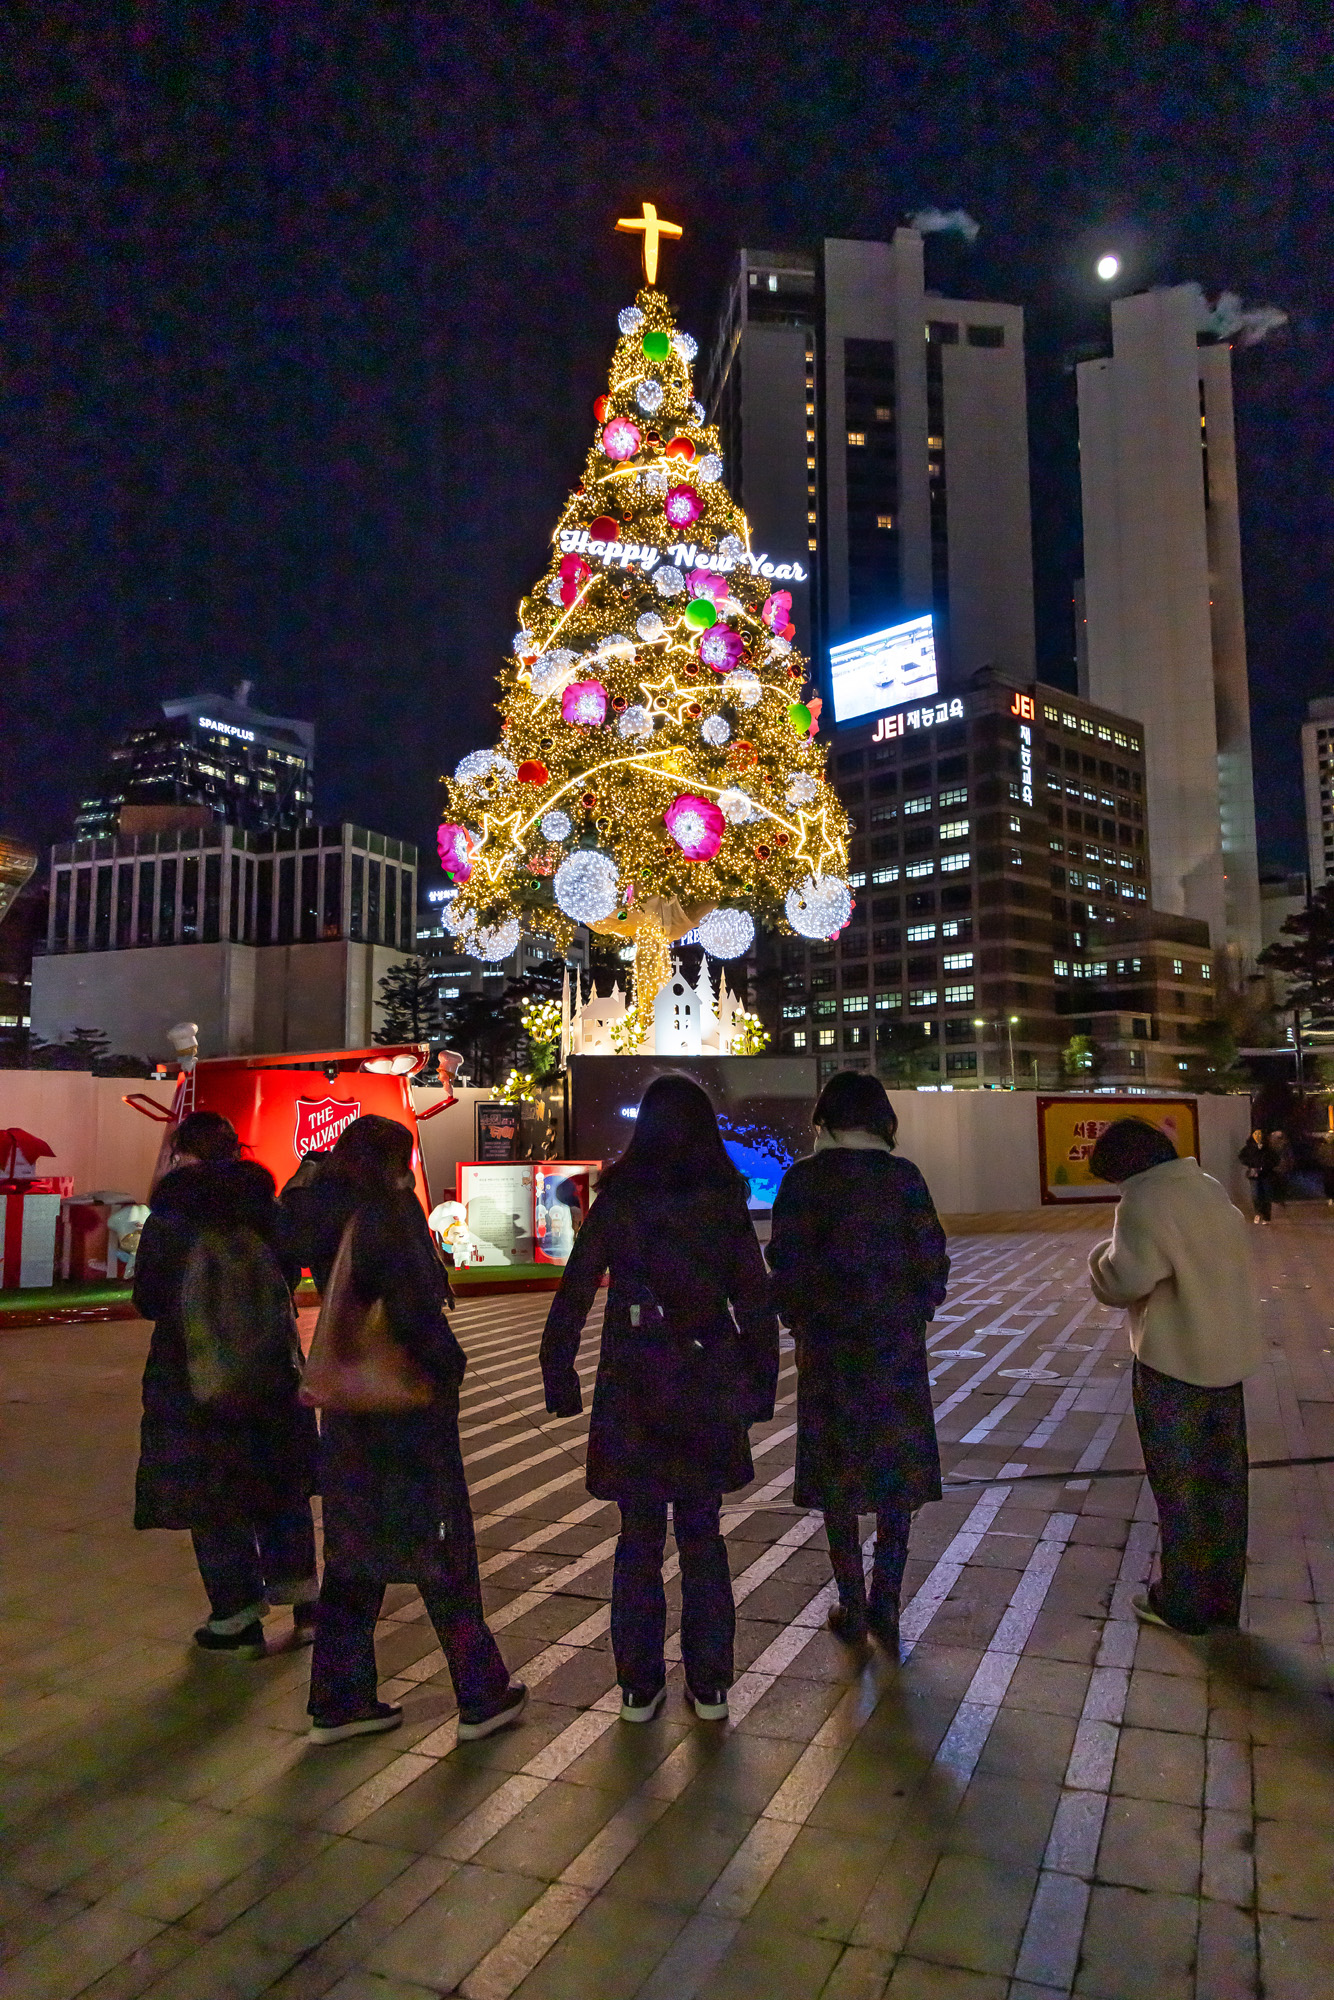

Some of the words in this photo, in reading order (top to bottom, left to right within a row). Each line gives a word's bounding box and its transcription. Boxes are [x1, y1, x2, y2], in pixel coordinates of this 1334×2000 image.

[559, 529, 660, 571] Happy
[667, 543, 737, 572] New
[740, 552, 808, 582] Year
[872, 713, 904, 742] JEI
[906, 698, 964, 729] 재능교육
[1010, 692, 1035, 721] JEI
[199, 717, 255, 741] SPARKPLUS
[1020, 725, 1033, 807] 재능교육
[308, 1105, 335, 1130] THE
